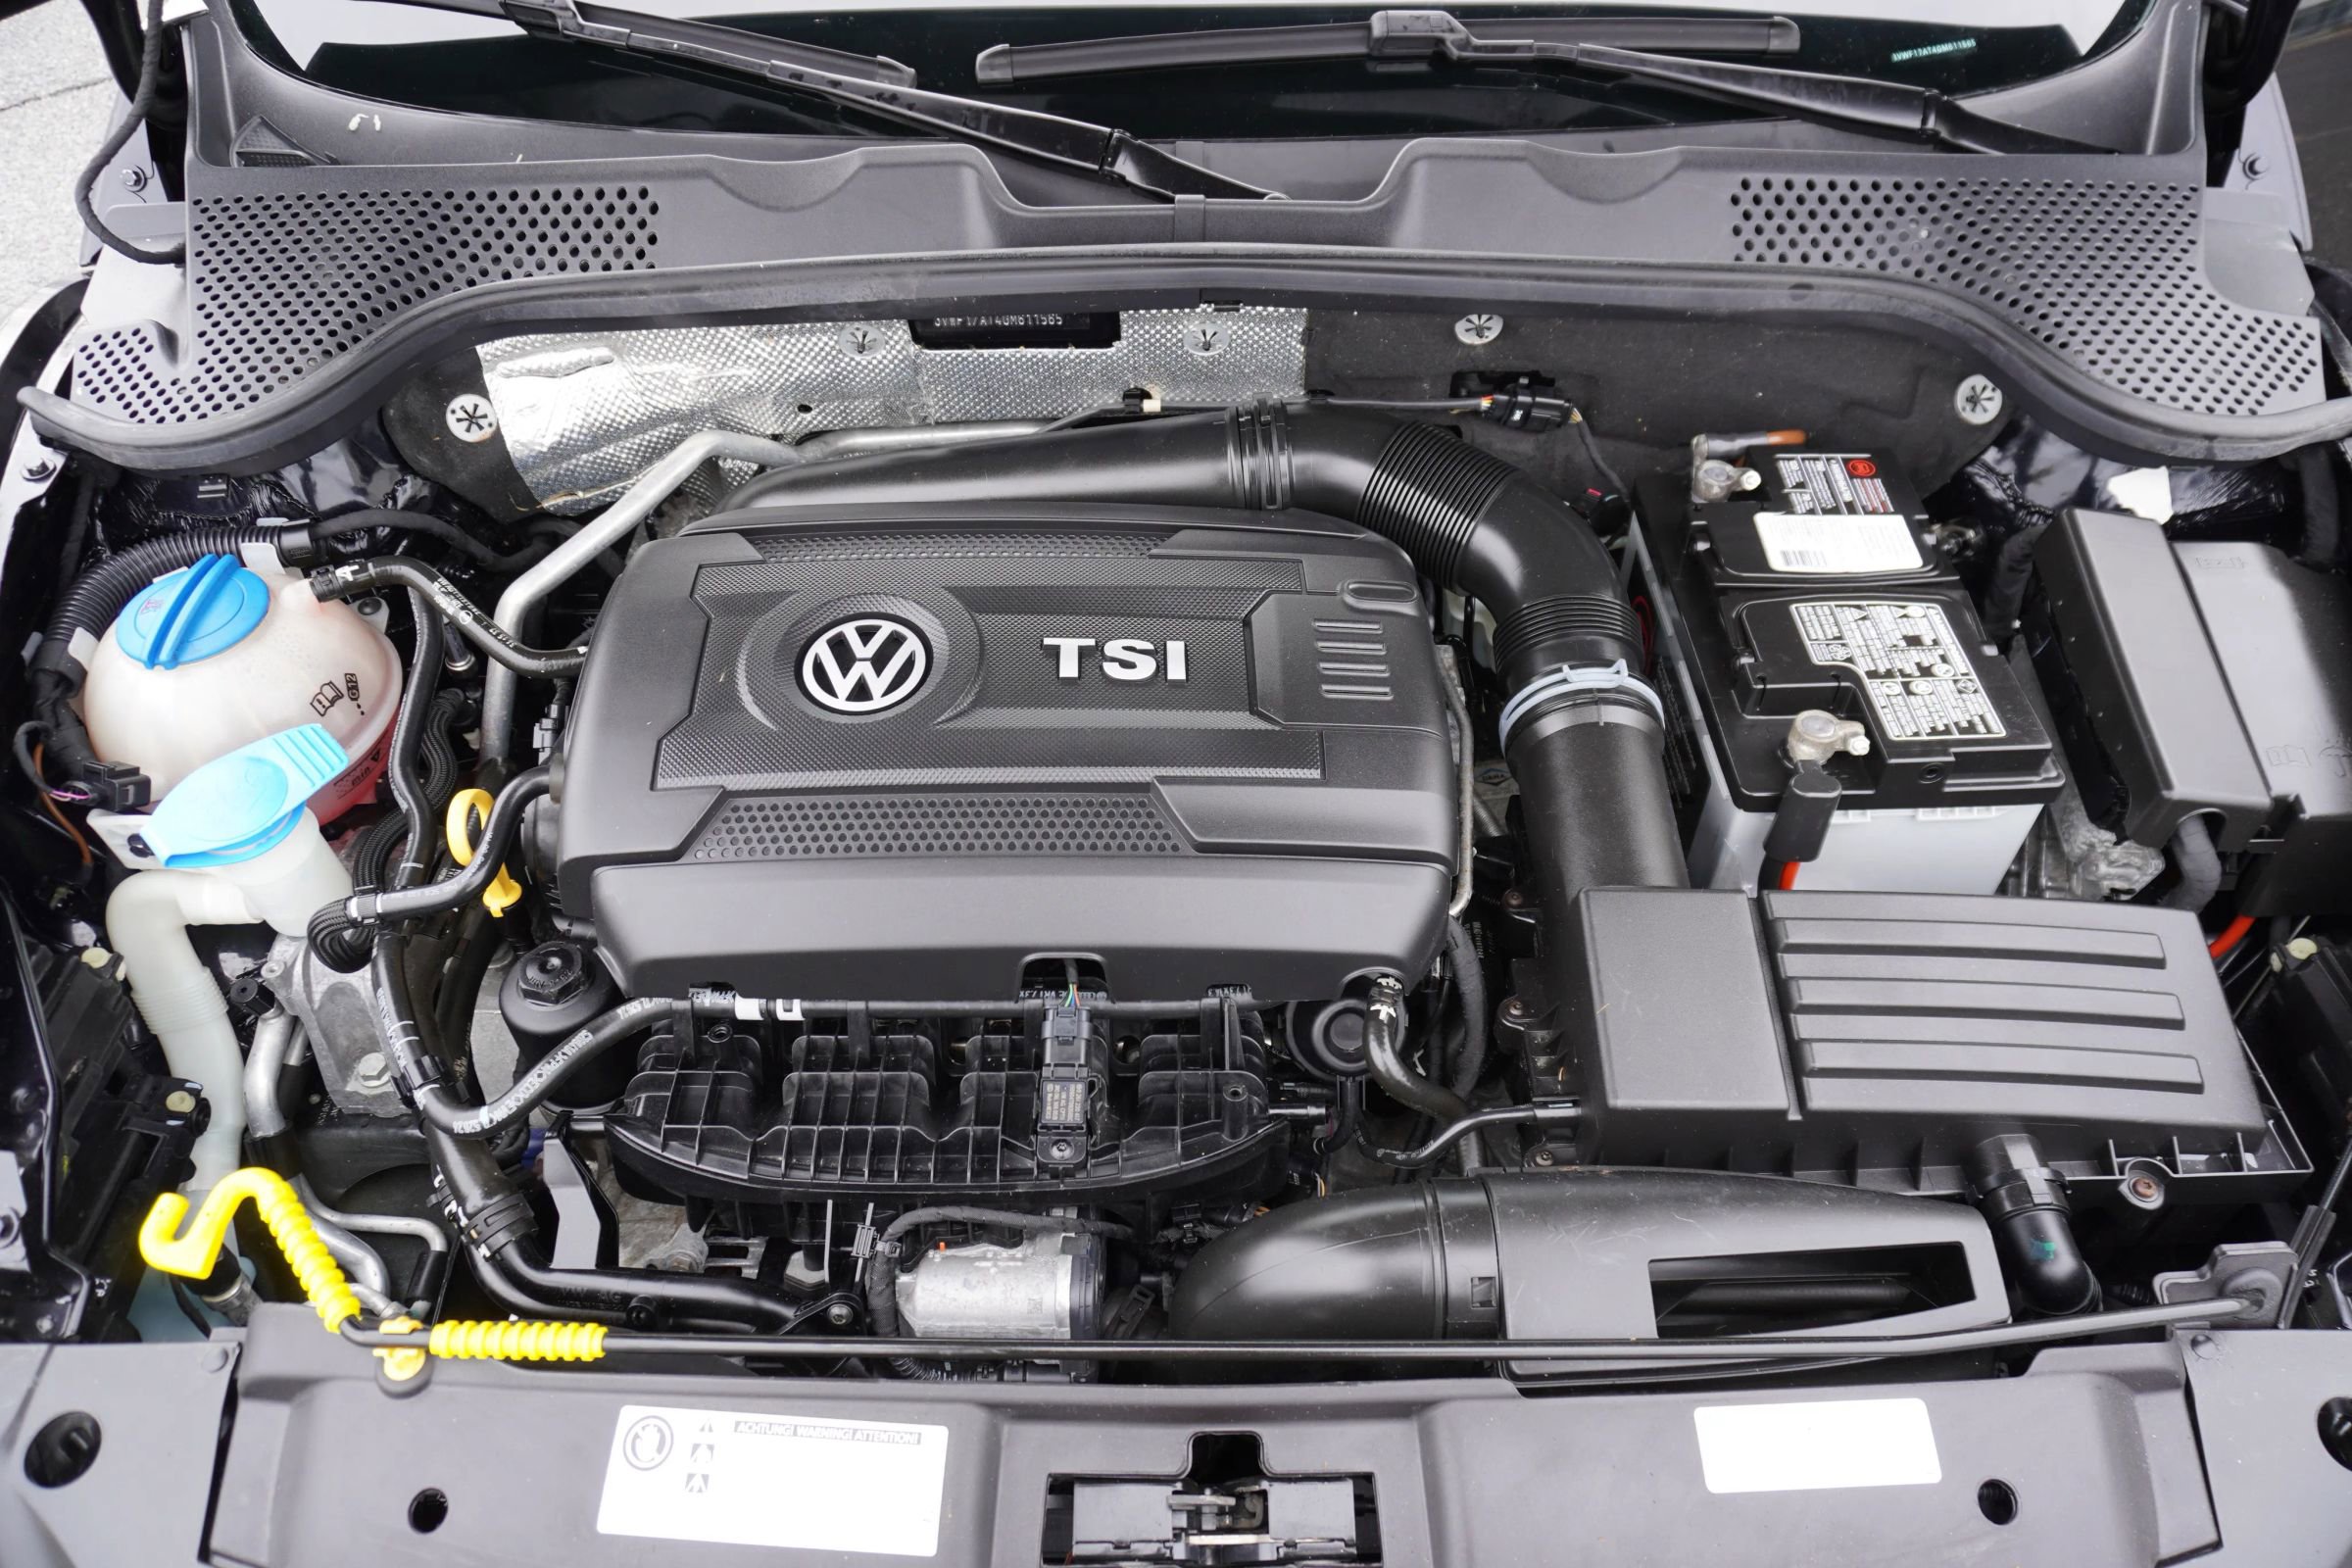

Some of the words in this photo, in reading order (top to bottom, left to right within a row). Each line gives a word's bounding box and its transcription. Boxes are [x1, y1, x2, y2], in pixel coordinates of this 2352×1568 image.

[1042, 636, 1190, 683] TSI
[345, 673, 360, 701] G12
[352, 765, 371, 786] min
[738, 1421, 794, 1437] ACHTUNG!
[797, 1426, 853, 1442] WARNING!
[854, 1430, 920, 1446] ATTENTION!
